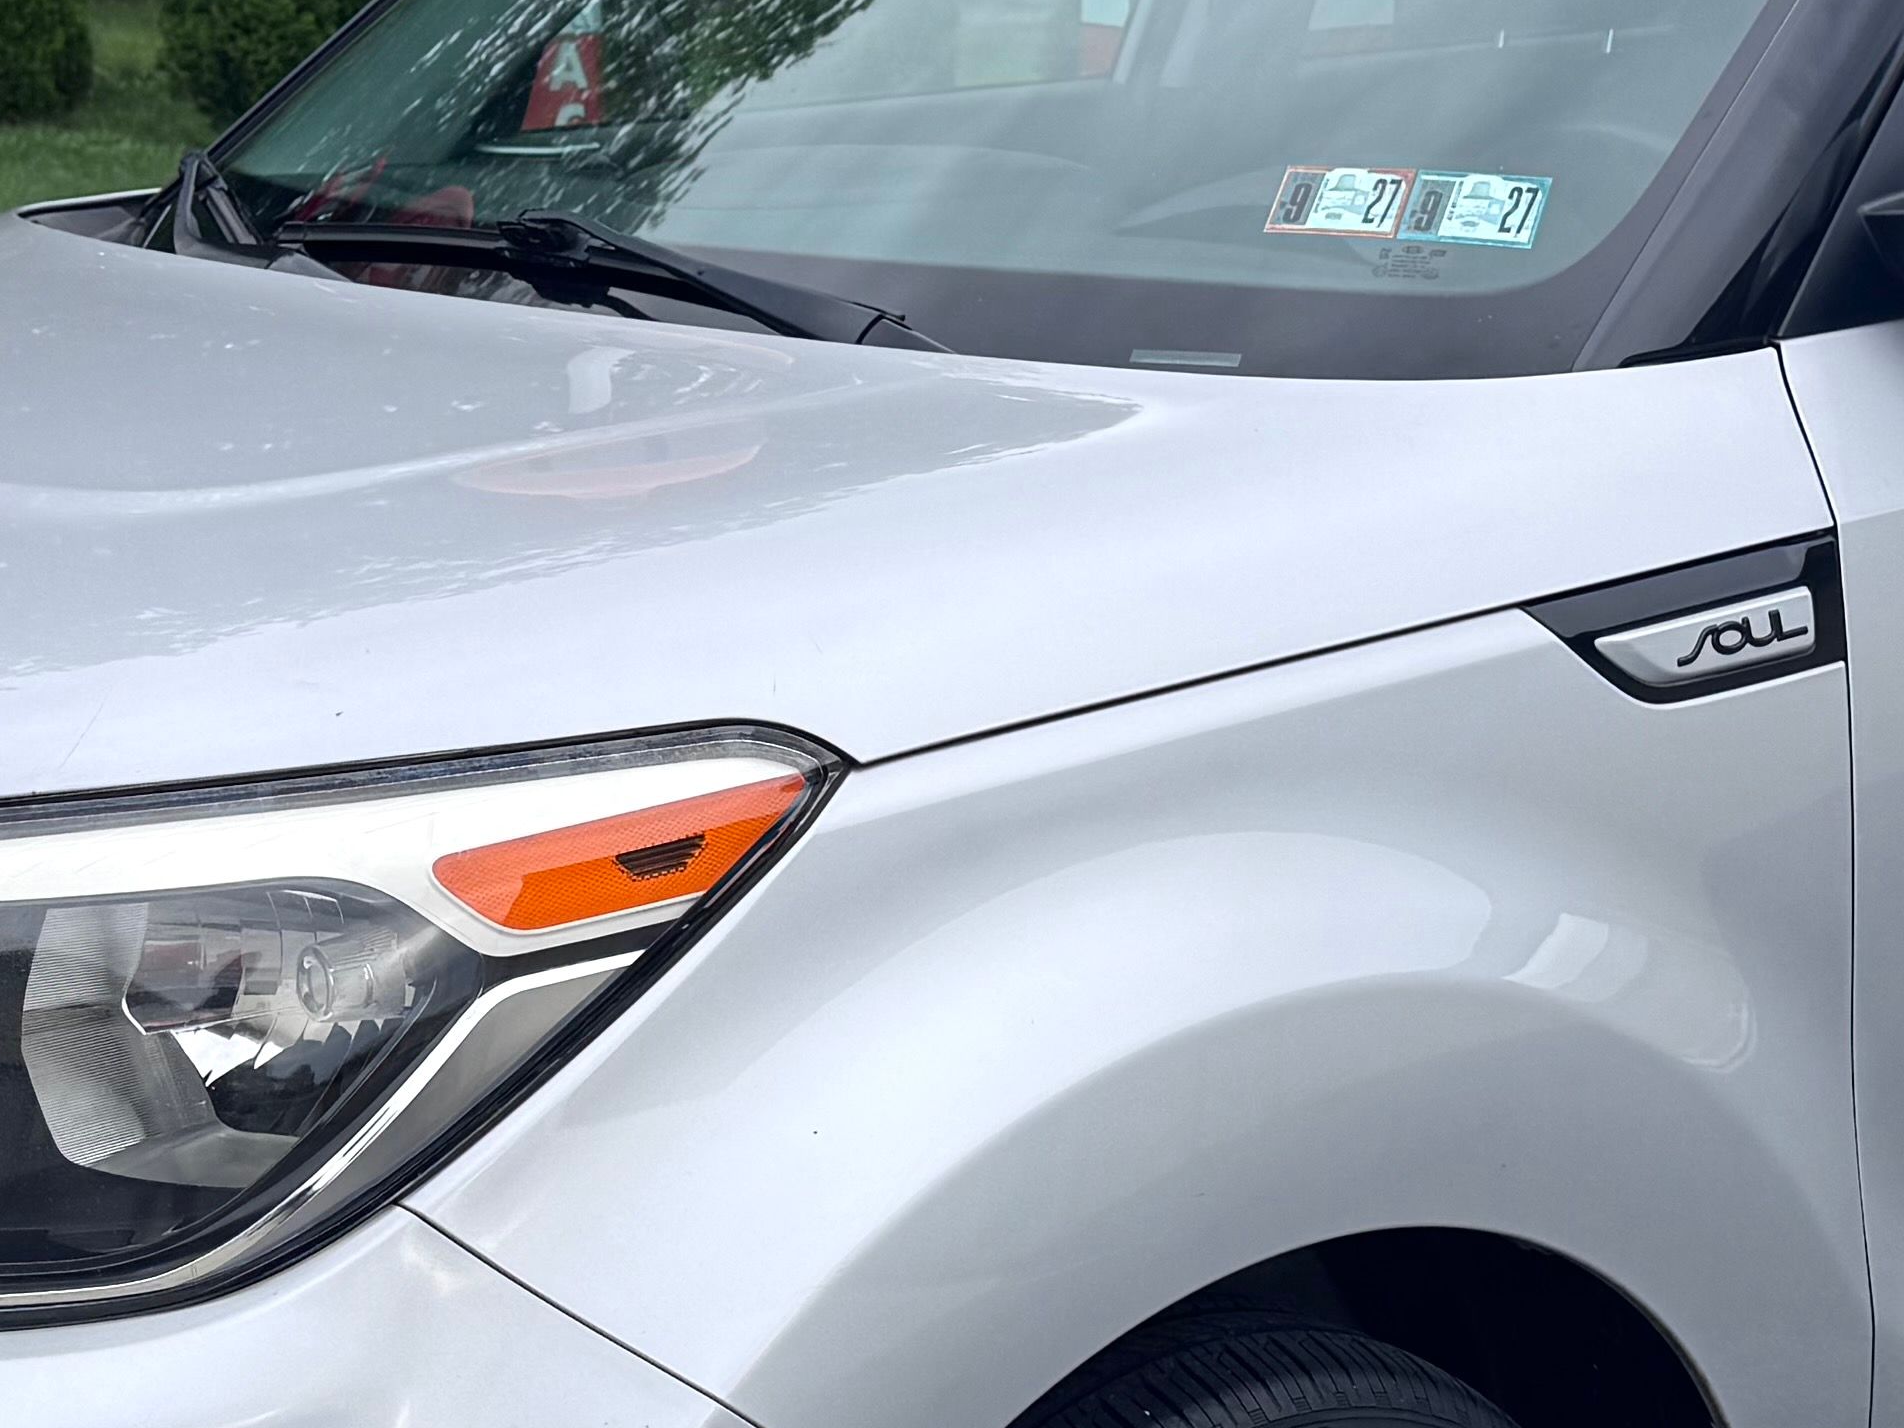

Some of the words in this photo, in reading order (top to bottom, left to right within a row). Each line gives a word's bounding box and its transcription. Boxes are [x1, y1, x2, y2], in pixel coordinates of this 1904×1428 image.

[1282, 183, 1313, 222] 9
[1362, 178, 1403, 228] 27
[1414, 190, 1444, 231] 9
[1498, 187, 1539, 235] 27
[1677, 608, 1809, 668] SOUL
